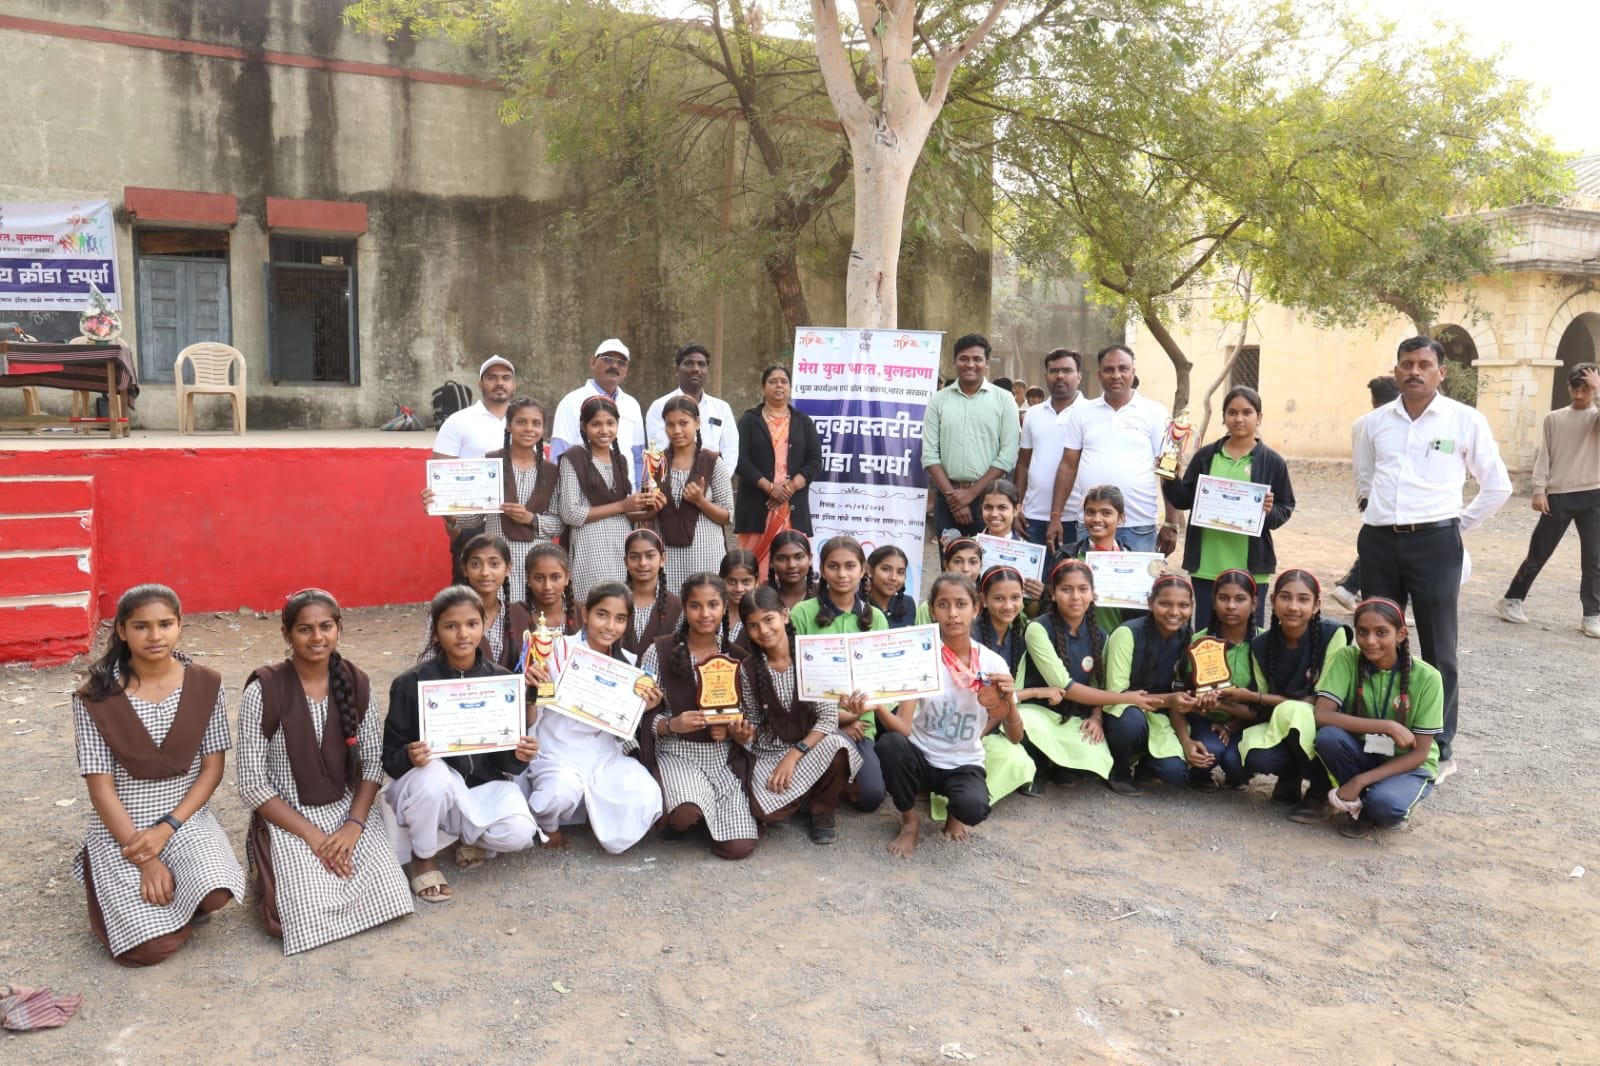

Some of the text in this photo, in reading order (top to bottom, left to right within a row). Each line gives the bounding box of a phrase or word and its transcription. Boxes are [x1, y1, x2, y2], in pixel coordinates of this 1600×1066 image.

[18, 262, 62, 285] क्रीडा
[66, 263, 109, 285] स्पर्धा
[798, 358, 818, 376] मेरा
[823, 362, 845, 379] युवा
[883, 365, 934, 382] बुलढाणा
[859, 448, 912, 477] स्पर्धा
